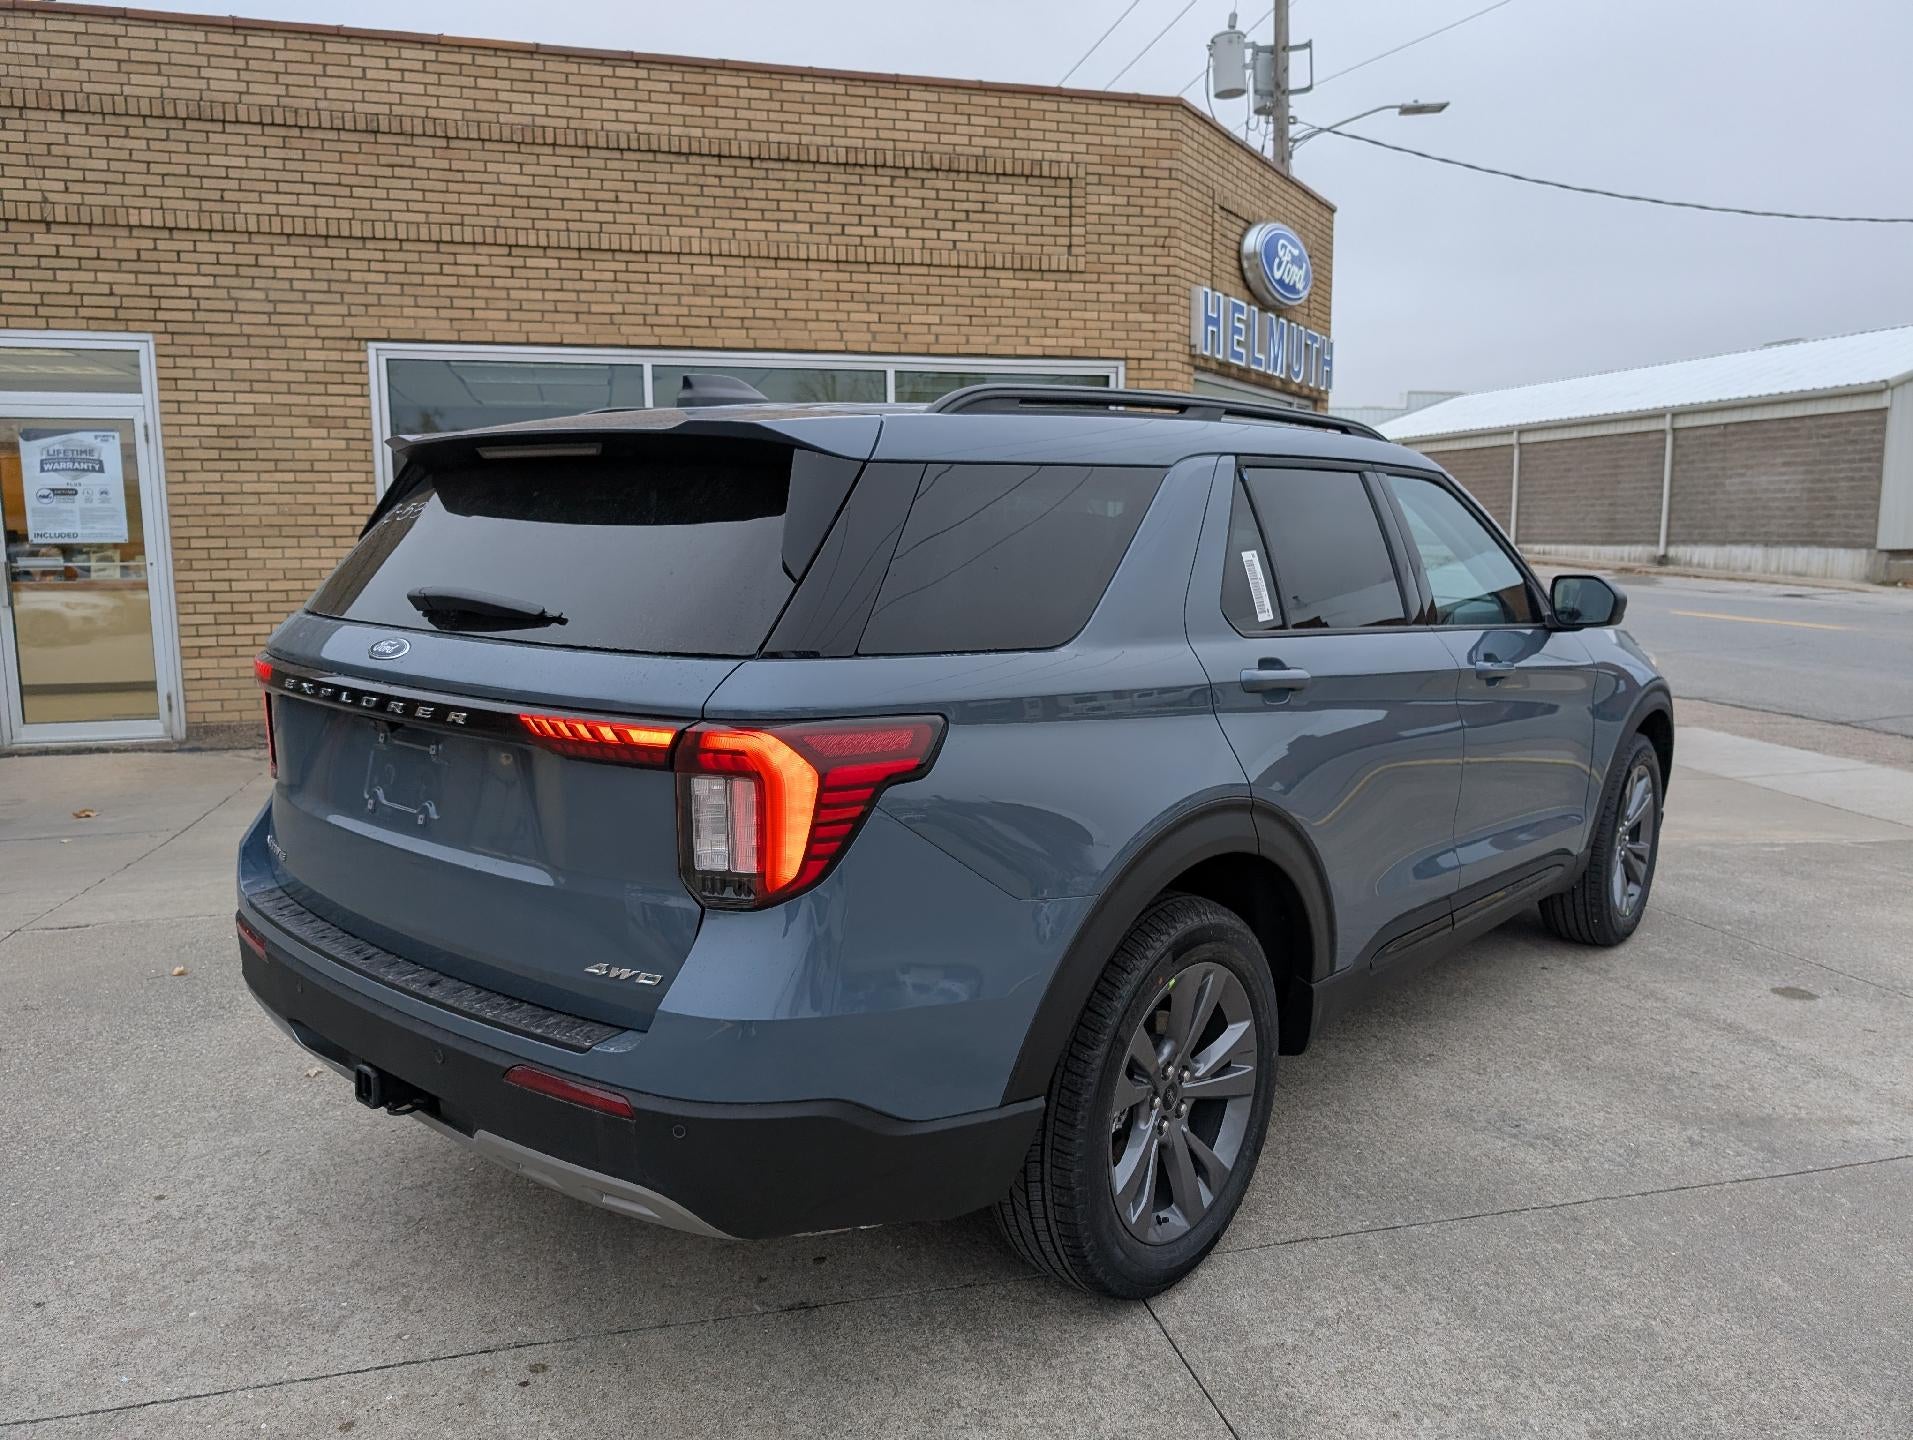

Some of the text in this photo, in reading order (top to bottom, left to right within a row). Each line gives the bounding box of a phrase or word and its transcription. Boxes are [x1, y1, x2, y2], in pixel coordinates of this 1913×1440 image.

[1273, 239, 1306, 292] Ford
[1201, 287, 1334, 391] HELMUTH
[46, 448, 95, 458] LIFETIME
[43, 461, 101, 472] WARRANTY
[33, 532, 79, 540] INCLUDED
[372, 640, 400, 654] Ford
[284, 678, 467, 725] EXPLORER
[584, 962, 663, 986] 4WD
